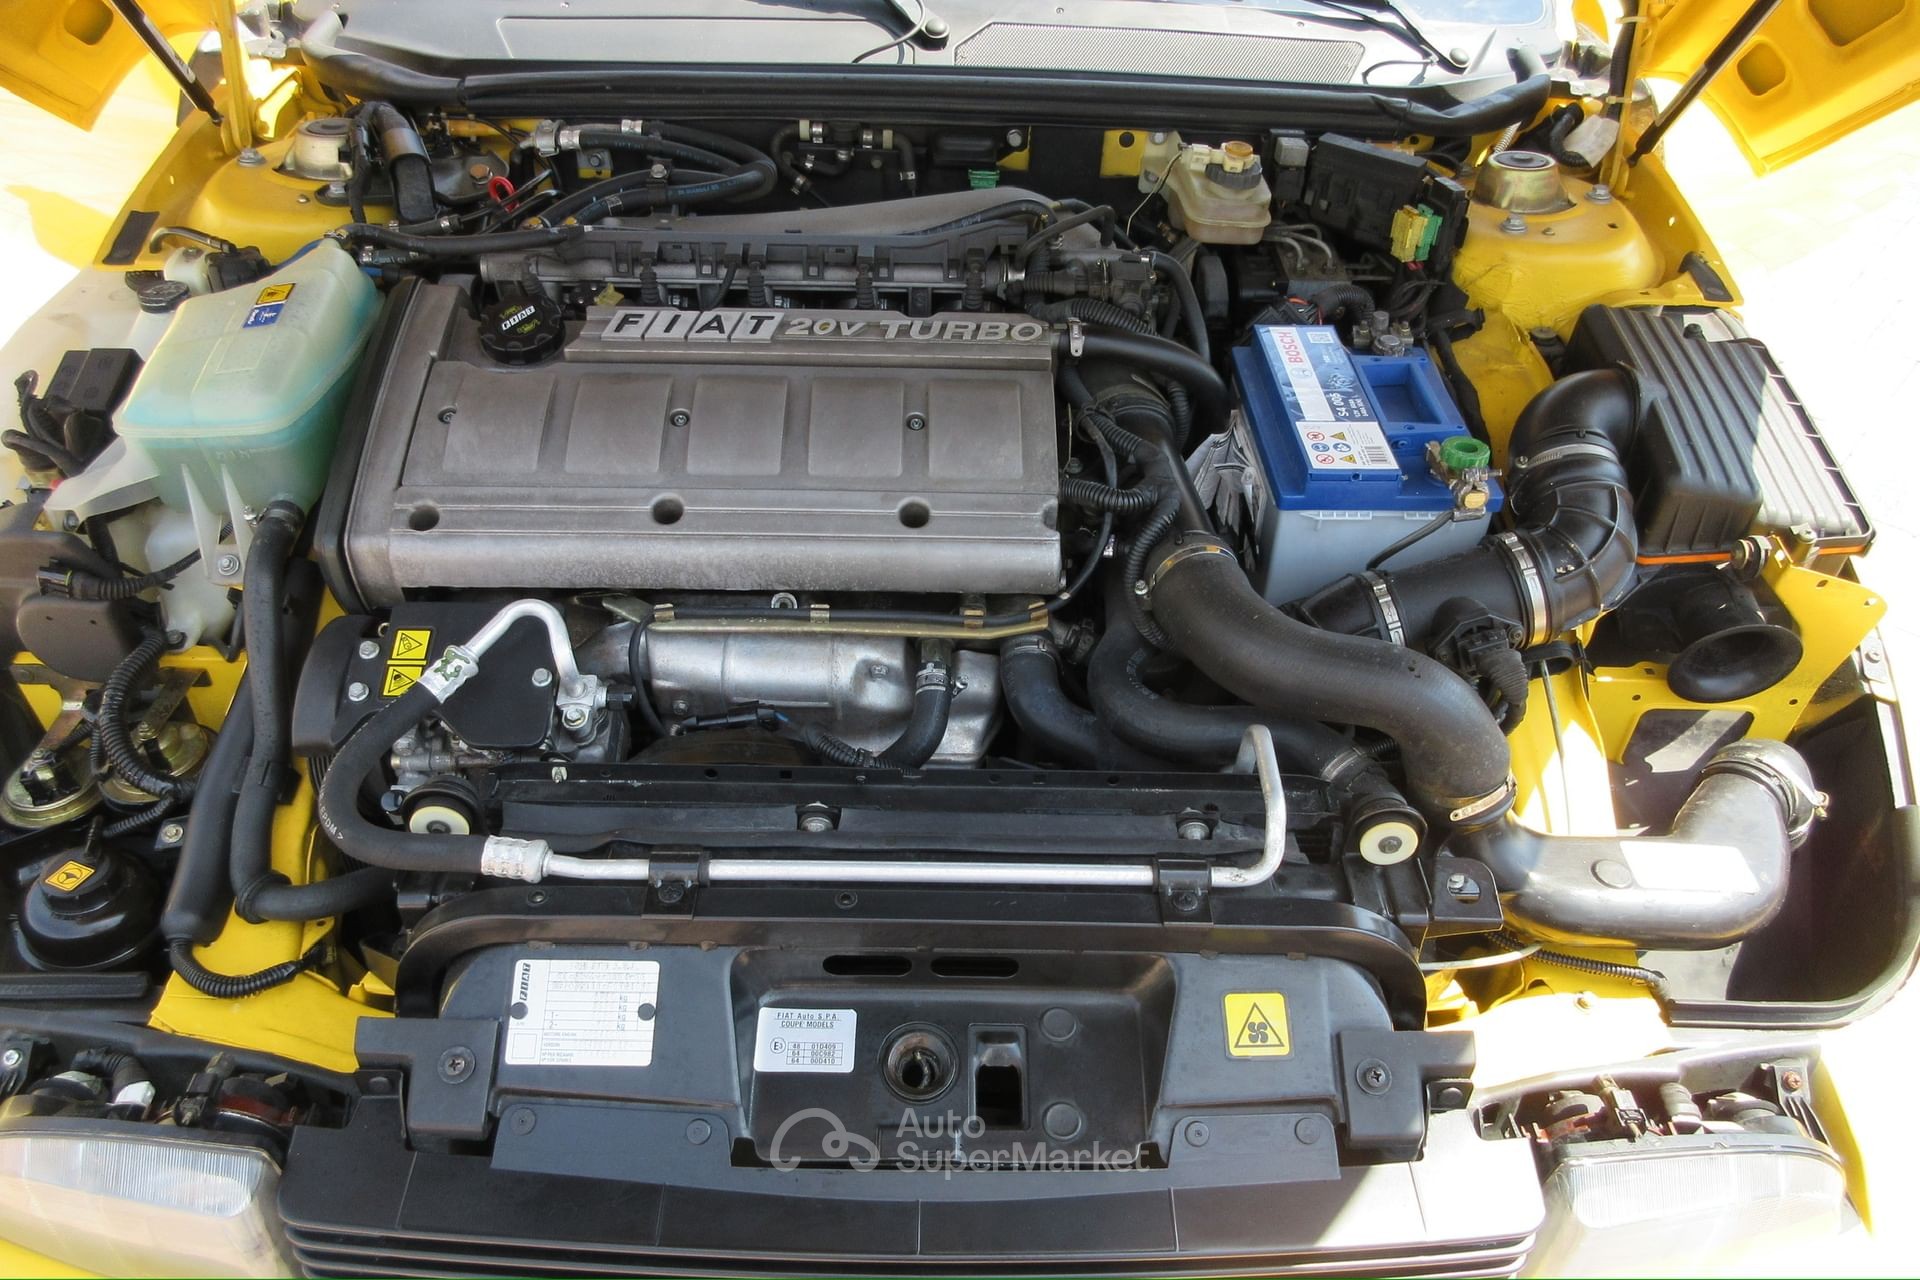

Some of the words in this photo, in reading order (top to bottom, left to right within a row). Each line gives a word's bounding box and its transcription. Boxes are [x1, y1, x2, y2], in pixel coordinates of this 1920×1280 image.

[502, 305, 536, 331] FIAT
[608, 312, 779, 337] FIAT
[879, 319, 1043, 341] TURBO
[1278, 331, 1304, 364] BOSCH
[1337, 406, 1350, 417] S4
[519, 962, 531, 1001] FIAT
[806, 1021, 834, 1029] MODELS
